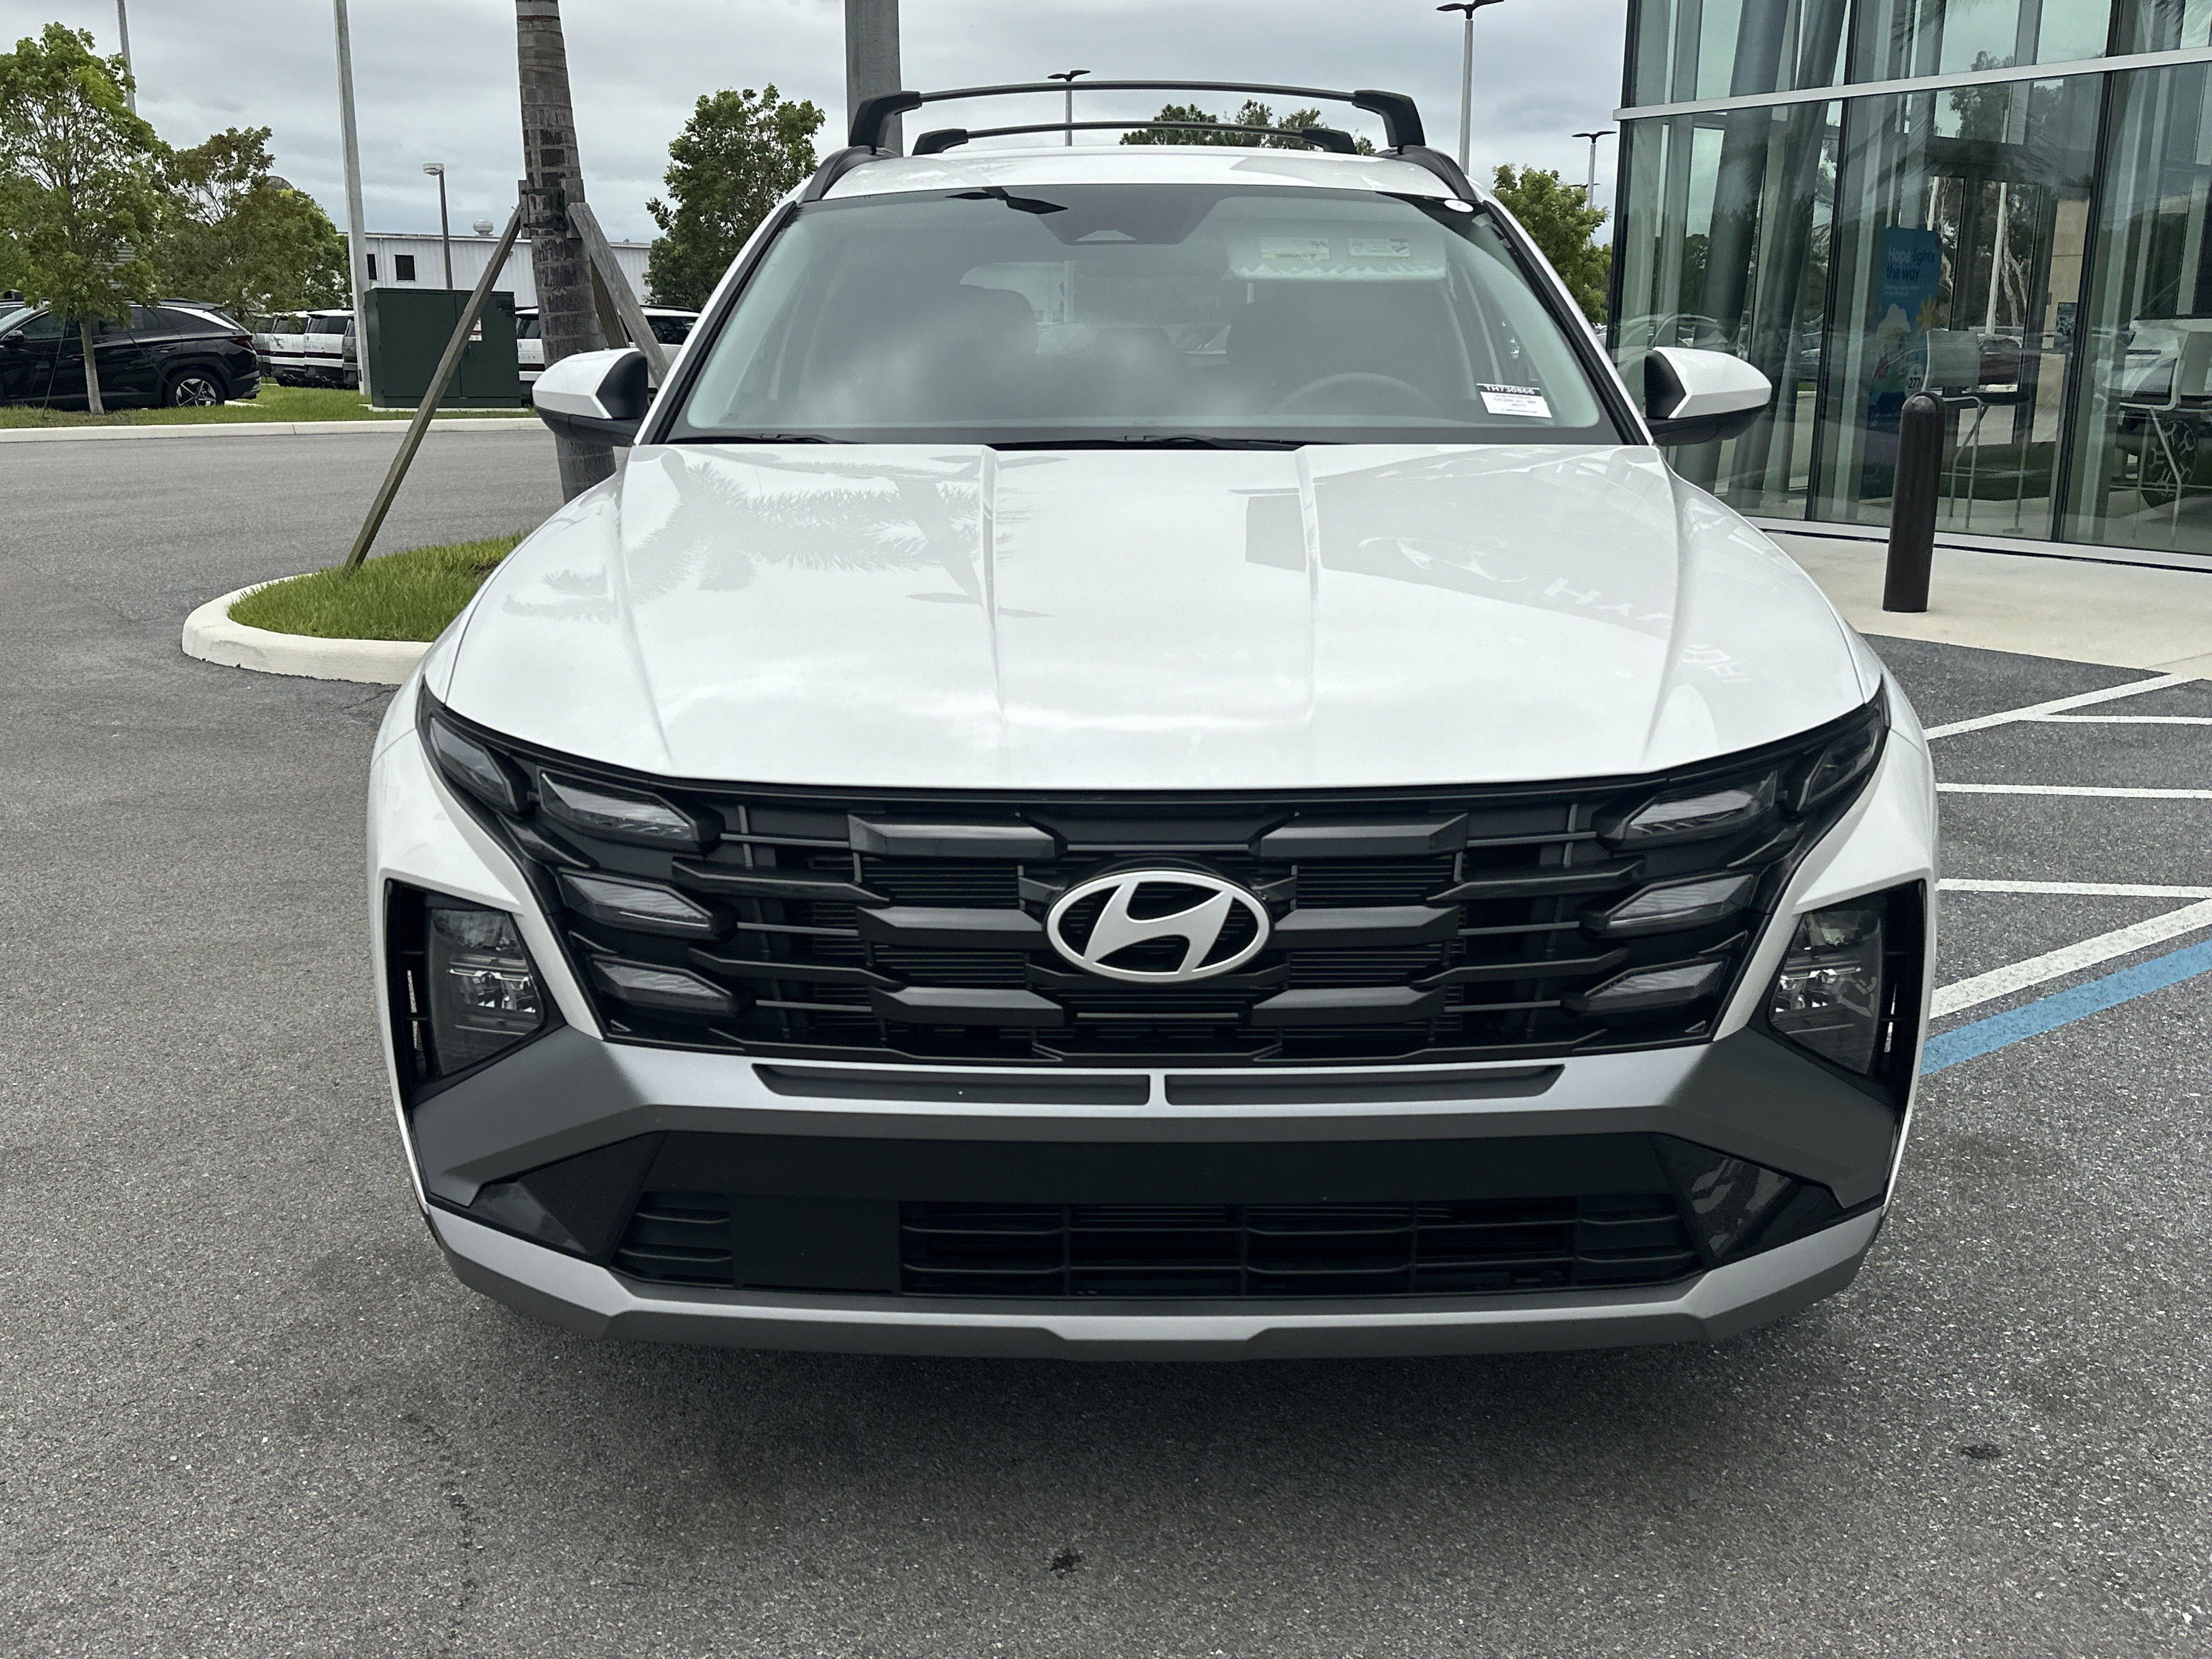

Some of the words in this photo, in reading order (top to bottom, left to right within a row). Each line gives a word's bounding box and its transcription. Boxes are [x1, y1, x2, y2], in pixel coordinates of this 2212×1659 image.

[1888, 247, 1911, 264] Hope
[1913, 247, 1934, 266] lights
[1886, 264, 1900, 279] the
[1902, 268, 1920, 283] way
